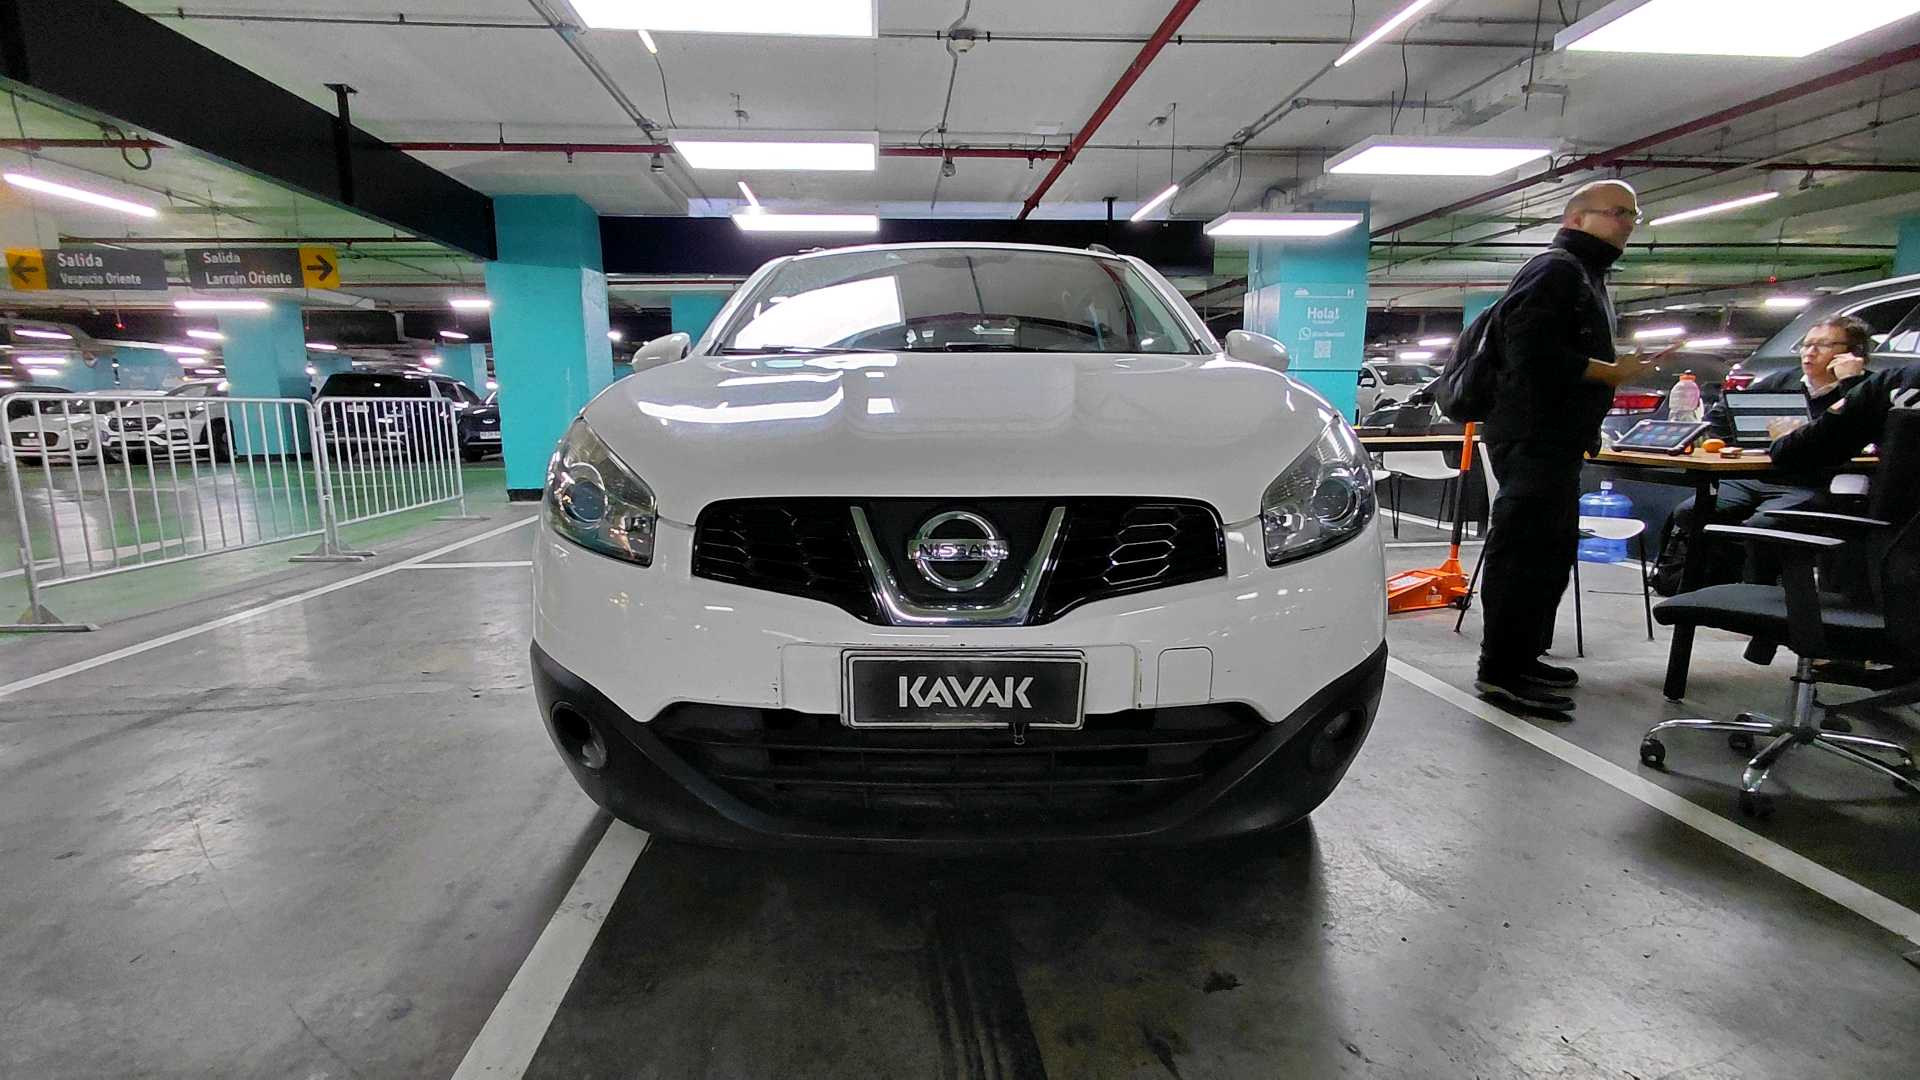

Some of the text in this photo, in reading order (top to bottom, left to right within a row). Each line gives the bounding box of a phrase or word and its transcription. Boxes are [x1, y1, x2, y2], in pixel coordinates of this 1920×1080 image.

[57, 252, 103, 268] Salida
[203, 252, 241, 264] Salida
[60, 273, 142, 287] Vespucio Oriente
[248, 271, 293, 285] Oriente
[1307, 306, 1340, 320] Hola!
[919, 542, 1001, 558] NISSAN
[898, 676, 1033, 708] KAVAK
